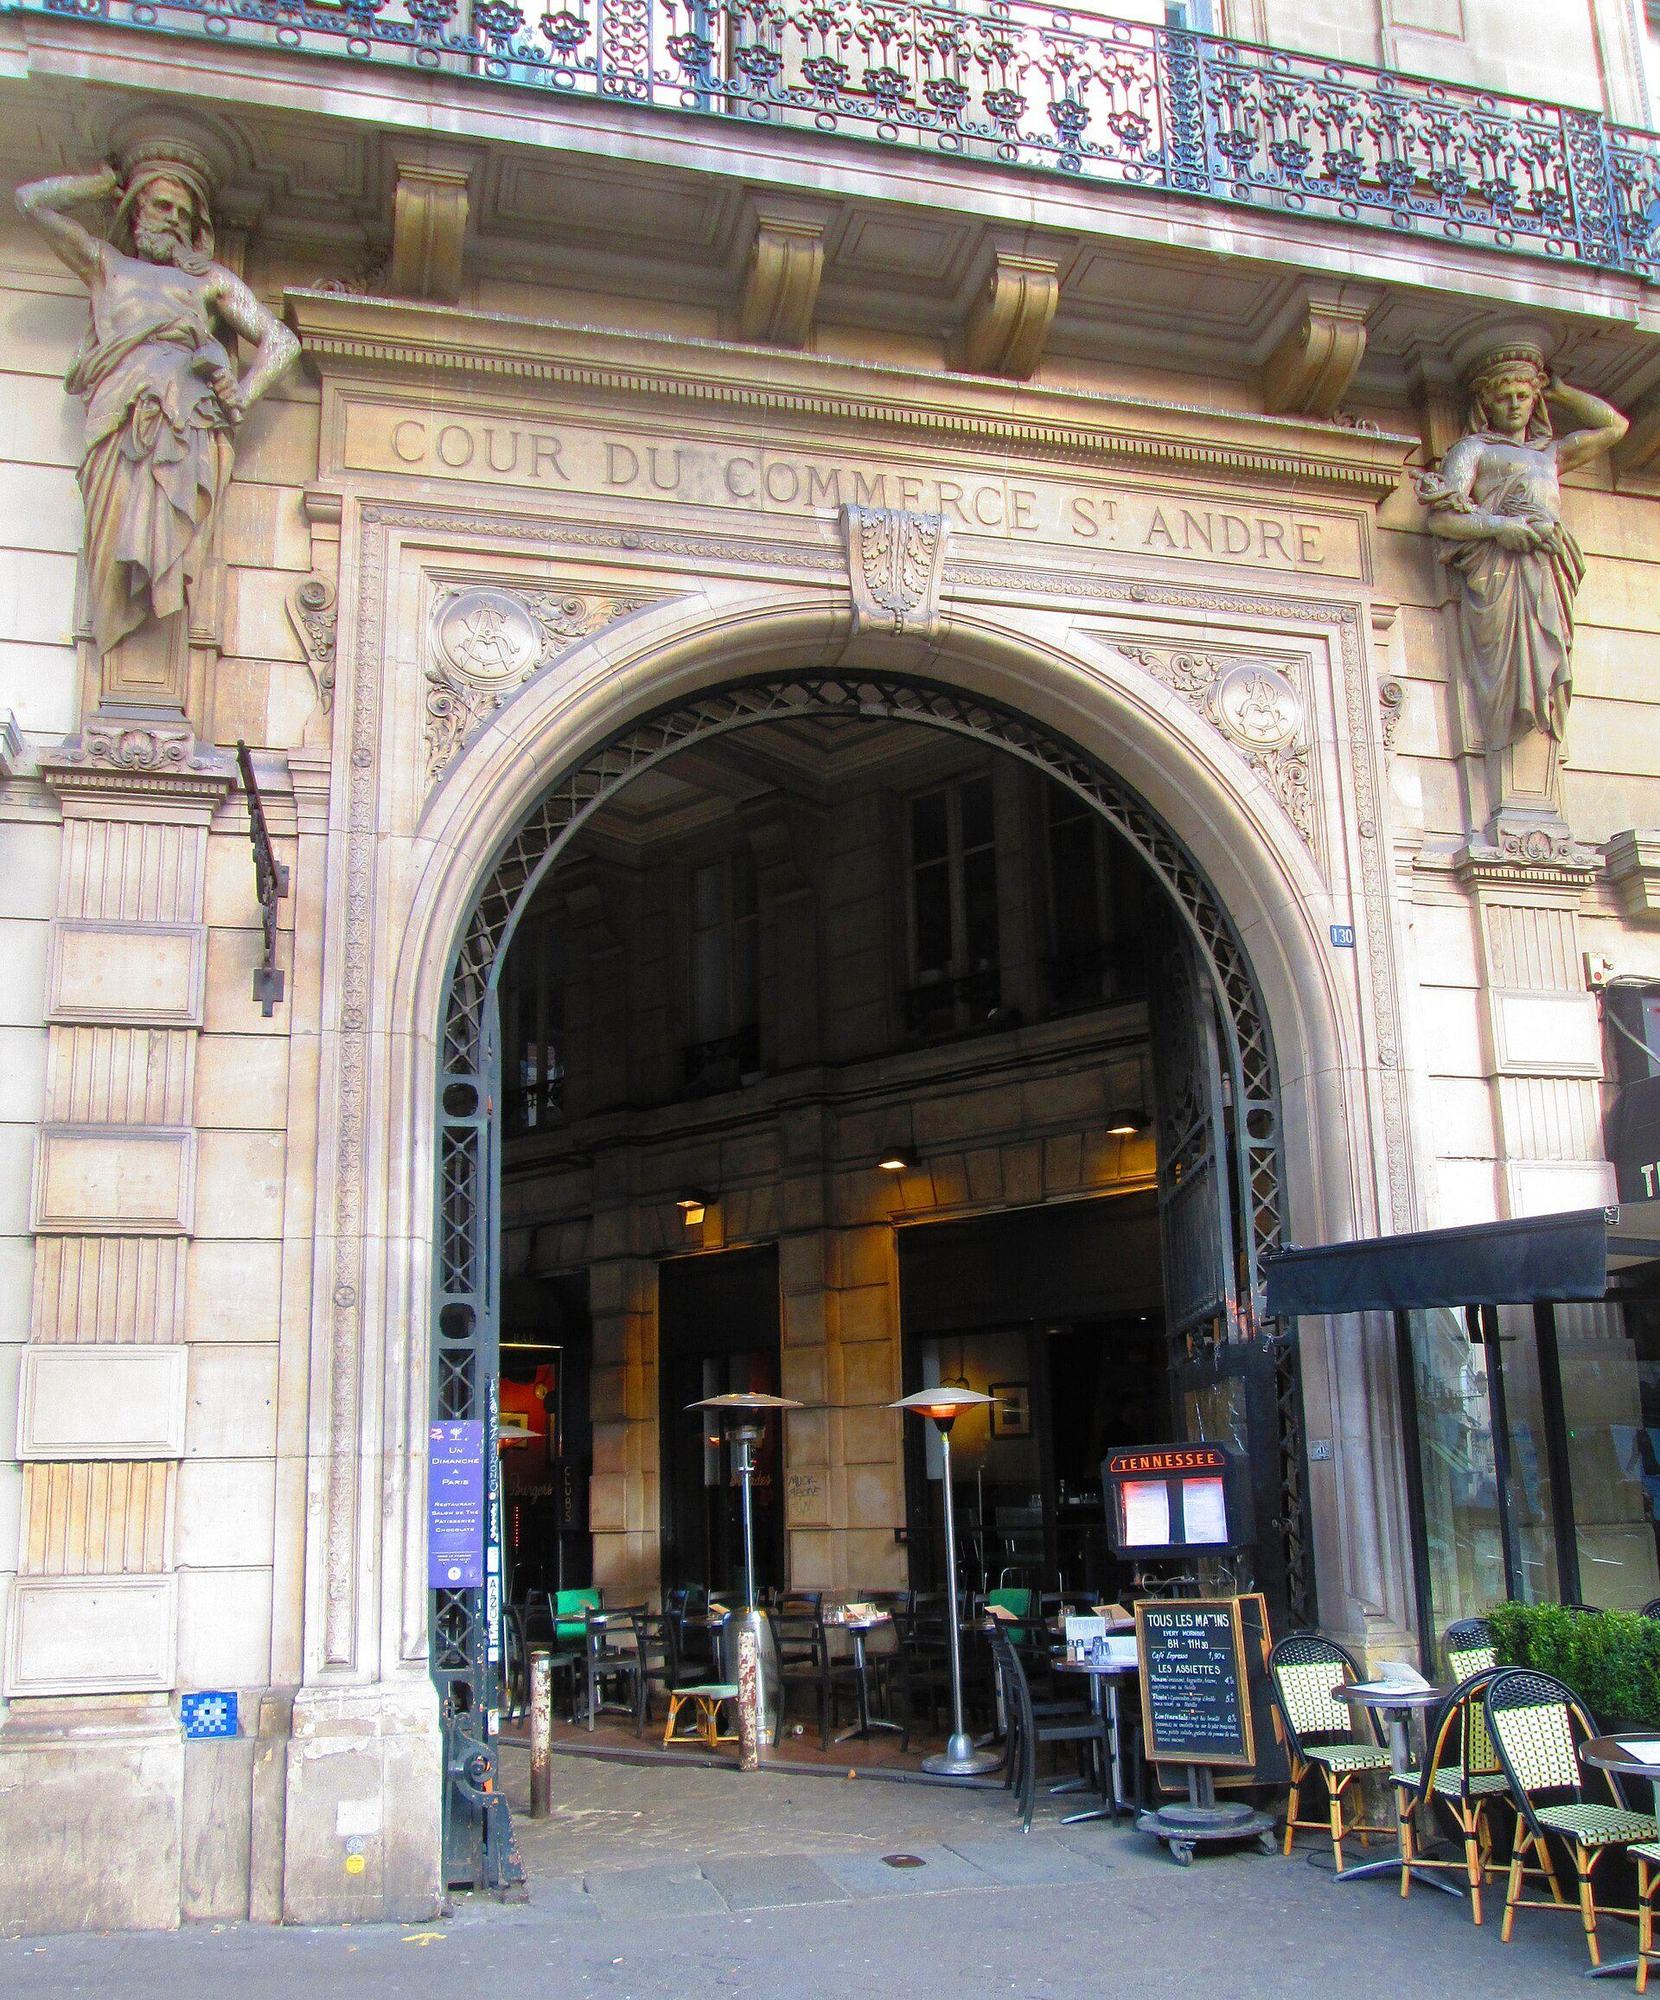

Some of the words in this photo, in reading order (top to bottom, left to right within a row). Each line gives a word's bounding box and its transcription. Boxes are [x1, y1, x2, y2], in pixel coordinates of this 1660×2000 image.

[392, 419, 569, 481] COUR
[602, 441, 685, 490] DU
[723, 456, 1041, 532] COMMERCE
[1142, 508, 1326, 565] ANDRE
[1332, 928, 1353, 944] 130
[1640, 1161, 1660, 1198] T
[432, 1457, 480, 1465] DIMANCHE
[1120, 1452, 1215, 1470] TENNESSEE
[442, 1478, 469, 1486] PARIS
[1147, 1614, 1173, 1627] TOUS
[1175, 1614, 1193, 1627] LES
[1167, 1639, 1179, 1649] 8H
[1151, 1651, 1164, 1662] Café
[1157, 1664, 1172, 1673] LES
[1175, 1665, 1221, 1675] ASSIETTES
